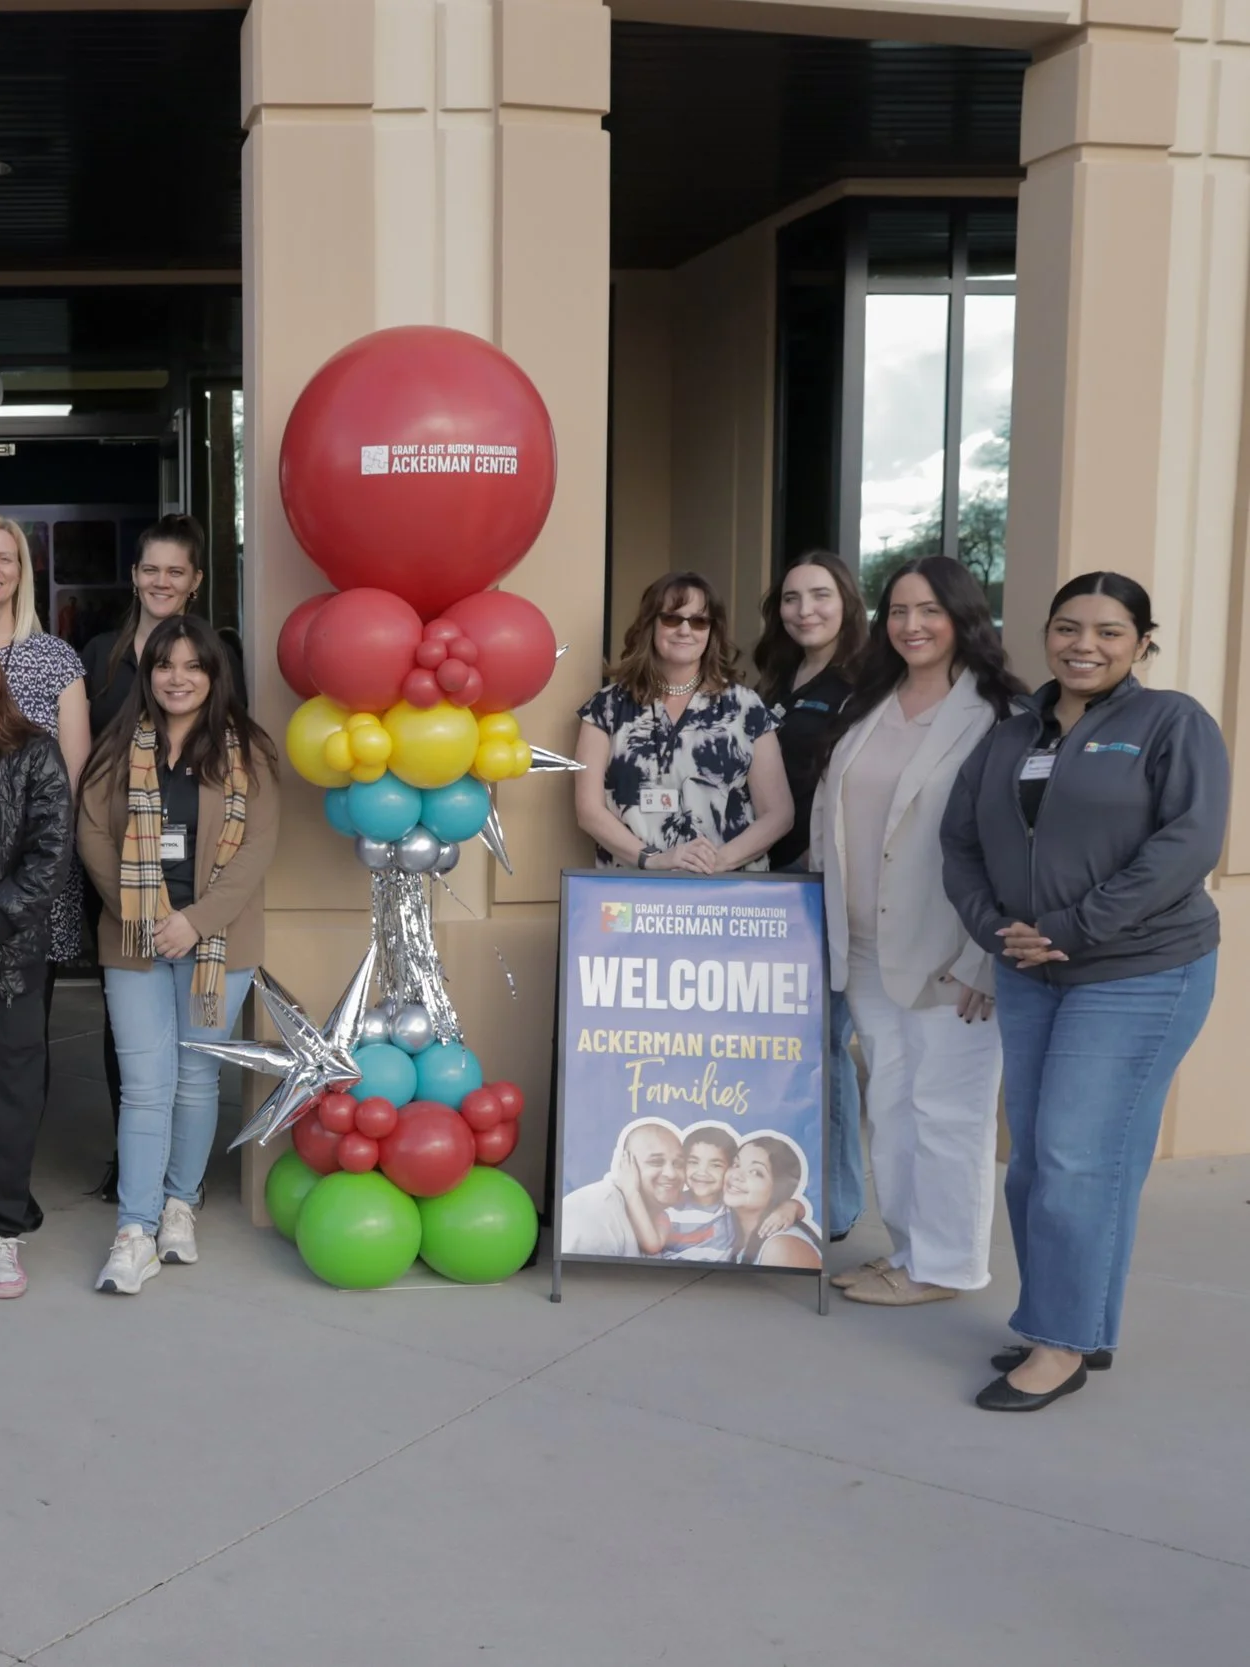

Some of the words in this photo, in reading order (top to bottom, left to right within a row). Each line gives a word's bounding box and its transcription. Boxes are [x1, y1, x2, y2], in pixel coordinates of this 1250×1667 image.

[392, 445, 419, 455] GRANT
[420, 445, 427, 455] A
[448, 444, 474, 454] AUTISM
[476, 445, 517, 457] FOUNDATION
[391, 456, 470, 473] ACKERMAN
[474, 456, 518, 475] CENTER
[635, 903, 665, 915] GRANT
[666, 904, 673, 915] A
[697, 905, 728, 917] AUTISM
[731, 906, 787, 918] FOUNDATION
[634, 916, 723, 936] ACKERMAN
[729, 918, 788, 938] CENTER
[578, 955, 809, 1015] WELCOME!
[577, 1028, 703, 1057] ACKERMAN
[710, 1034, 803, 1061] CENTER
[625, 1057, 751, 1115] Families
